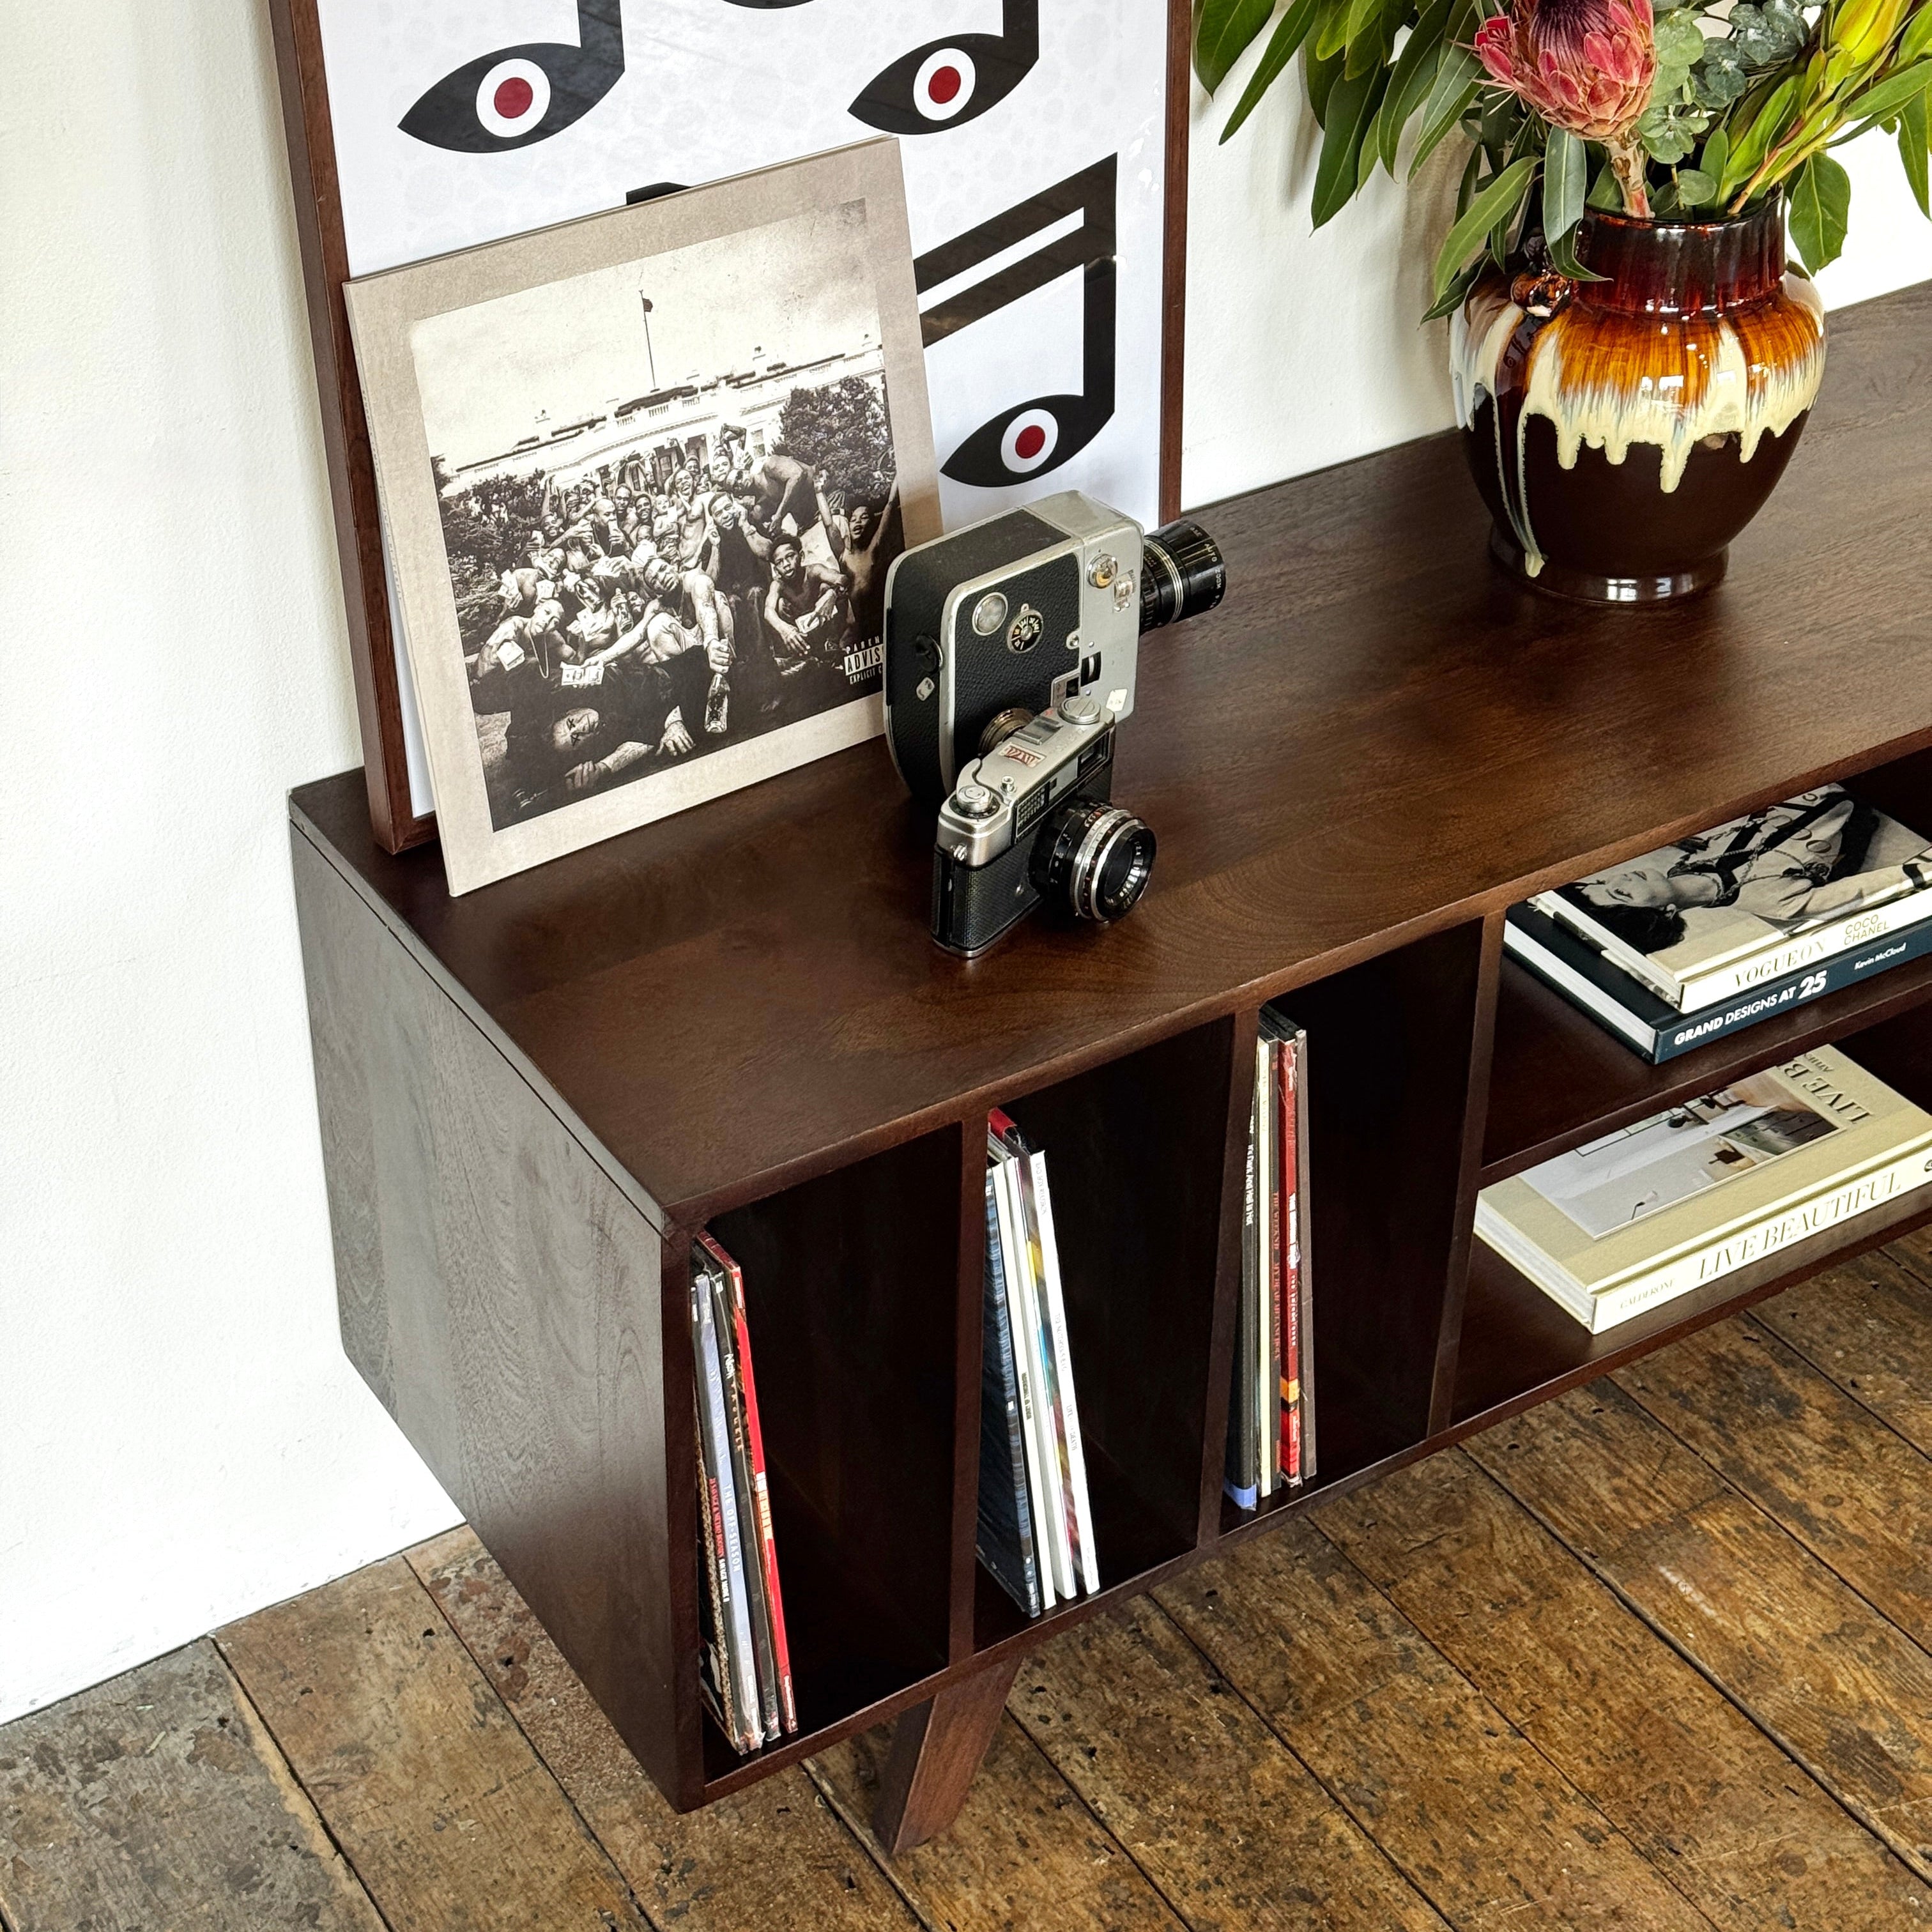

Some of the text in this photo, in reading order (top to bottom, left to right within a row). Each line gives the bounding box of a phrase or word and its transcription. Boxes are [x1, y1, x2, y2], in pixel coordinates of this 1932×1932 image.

[846, 635, 880, 654] PAREN
[850, 667, 875, 685] EXPLICIT
[1844, 921, 1889, 946] CHANEL
[1845, 914, 1879, 935] COCO
[1735, 937, 1827, 987] VOGUE ON
[1854, 942, 1906, 970] Kevin McCloud
[1674, 970, 1828, 1045] GRAND DESIGNS AT 25
[1802, 1076, 1874, 1124] LIVE
[1698, 1172, 1901, 1280] LIVE BEAUTIFUL
[1619, 1278, 1675, 1310] CALDERONE
[722, 1483, 733, 1505] THE
